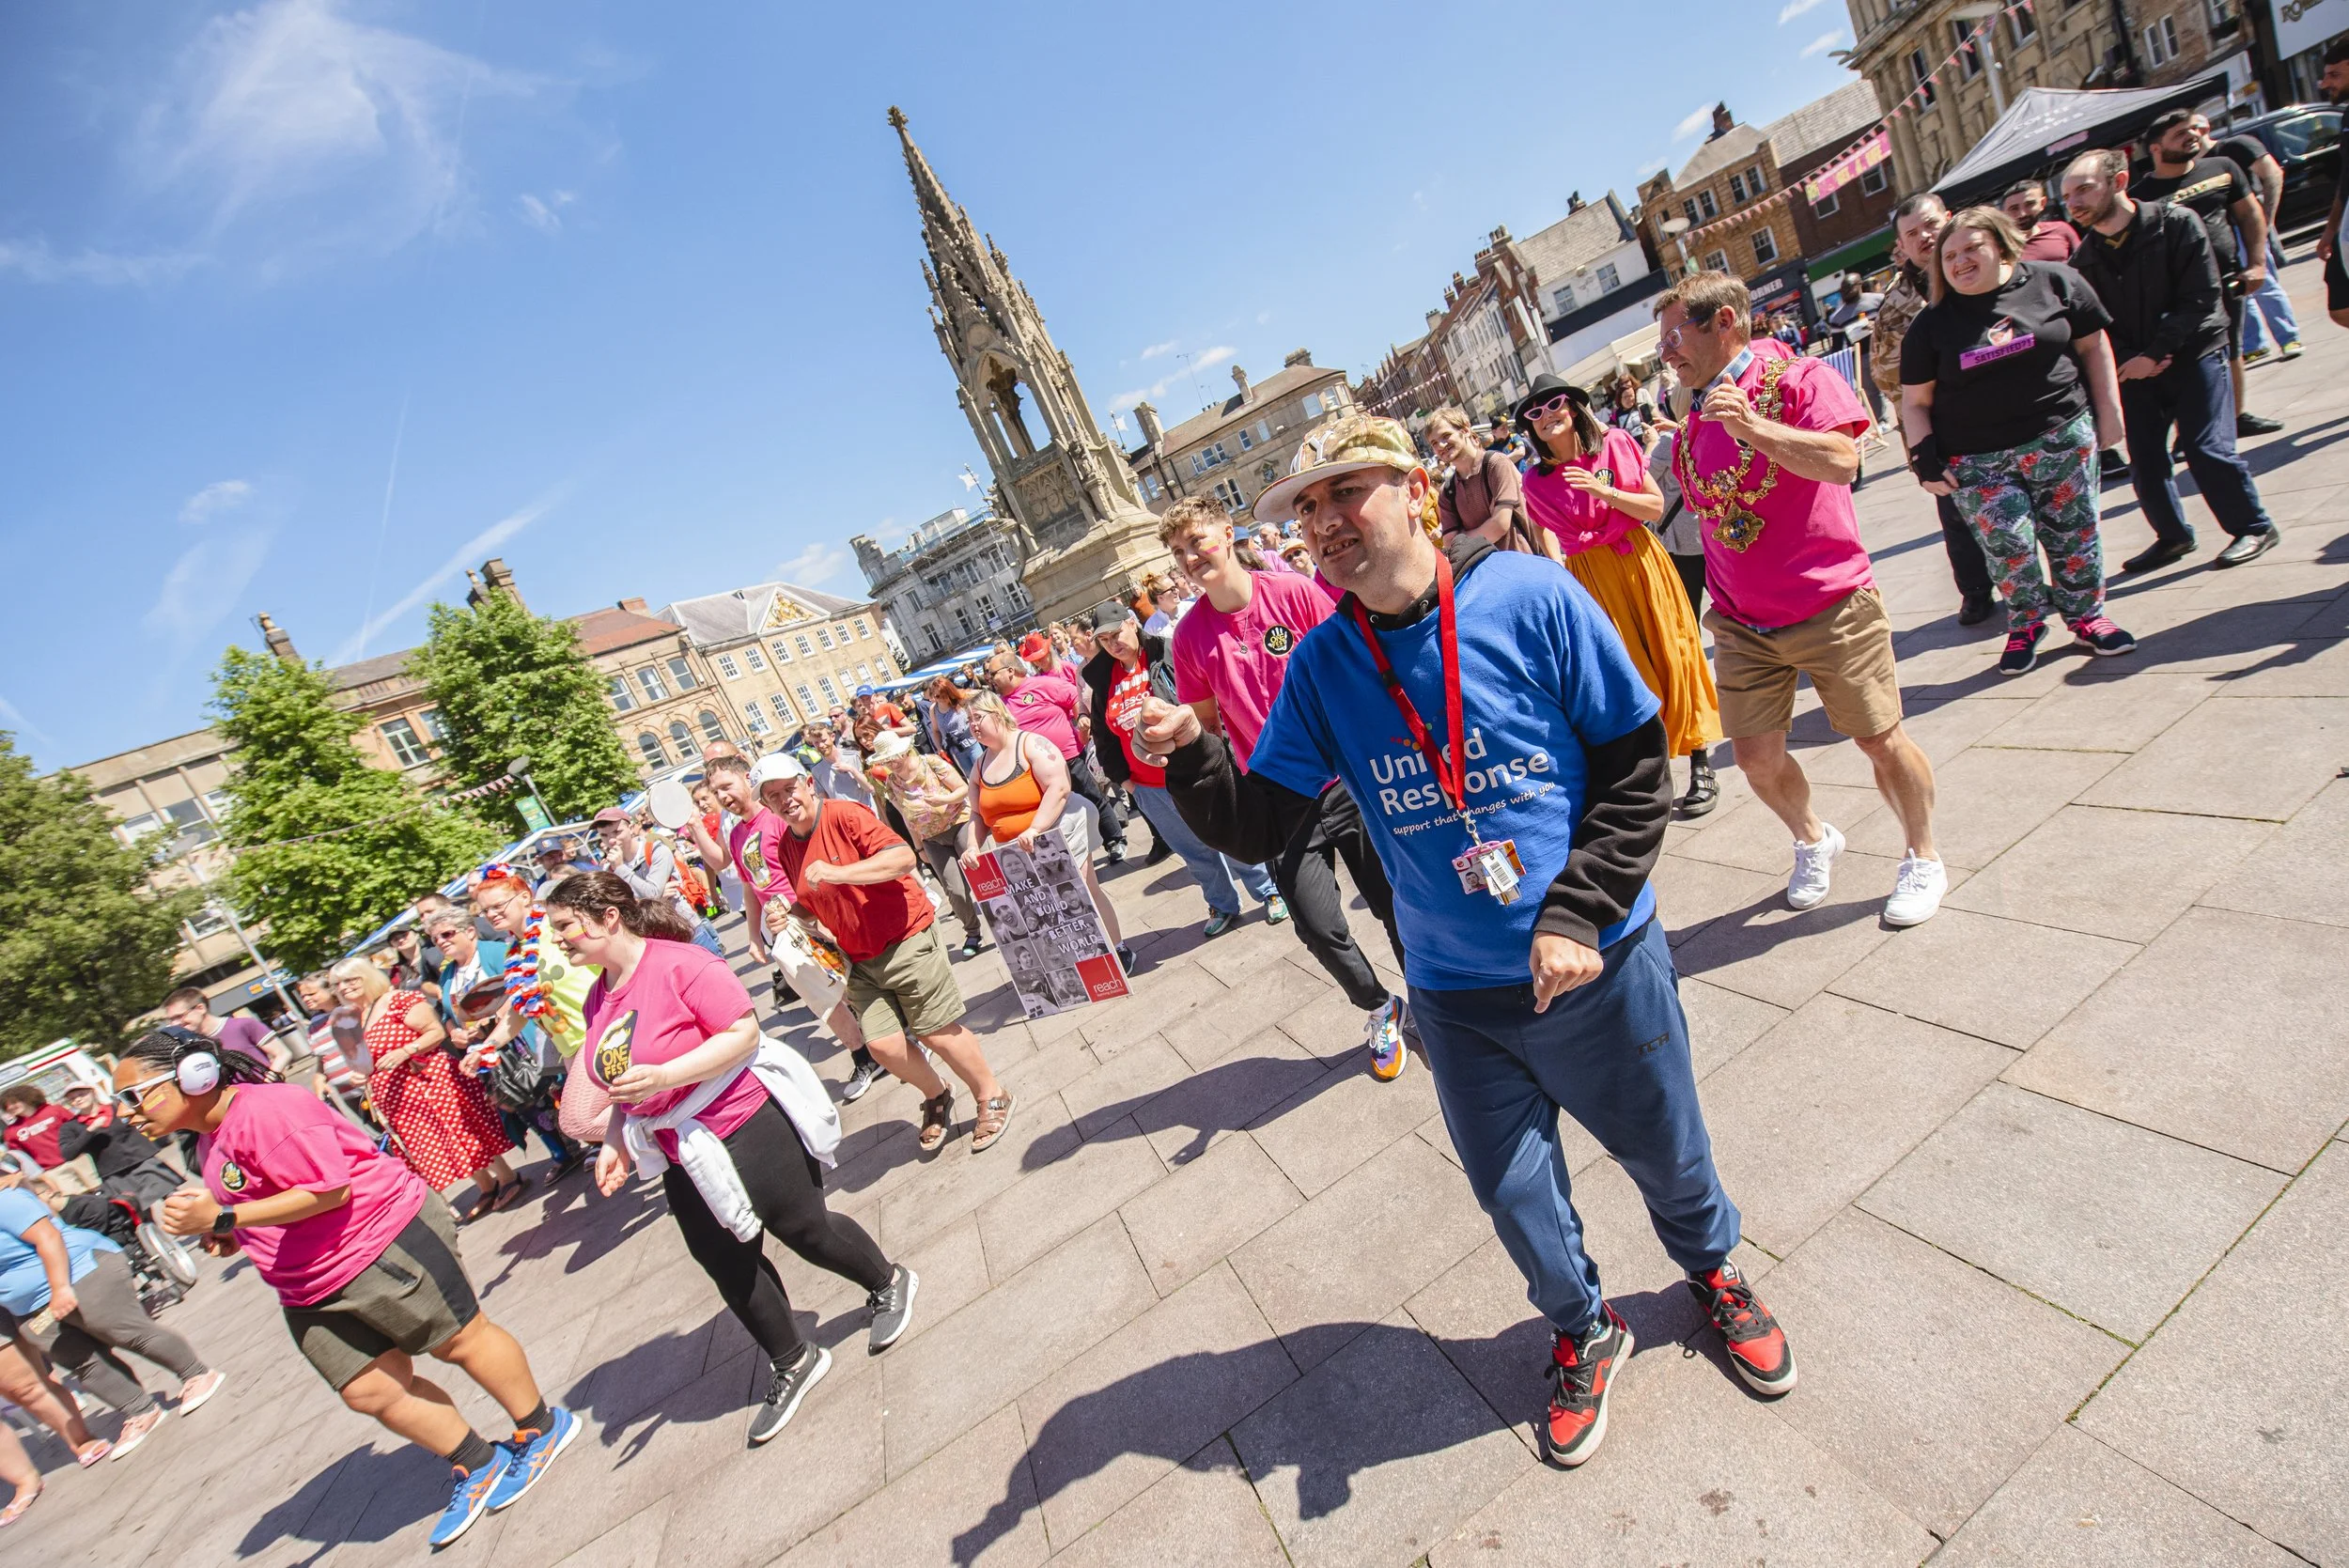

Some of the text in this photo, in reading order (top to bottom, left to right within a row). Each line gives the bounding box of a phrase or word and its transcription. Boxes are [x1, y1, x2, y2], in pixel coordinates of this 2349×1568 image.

[1750, 278, 1783, 301] ORNER
[1120, 691, 1150, 710] TESCO
[1370, 727, 1487, 784] Unied
[1393, 820, 1430, 835] support
[1434, 812, 1459, 827] that
[1510, 791, 1536, 804] with
[1539, 782, 1556, 797] you
[977, 877, 1004, 893] reach
[1003, 878, 1034, 895] MAKE
[1023, 891, 1047, 905] AND
[1035, 900, 1068, 917] BUILD
[1057, 913, 1066, 924] A
[1049, 919, 1087, 940] BETTER
[1058, 934, 1097, 954] WORLD
[1093, 979, 1123, 994] reach
[602, 1044, 629, 1066] ONE
[604, 1061, 628, 1080] FEST
